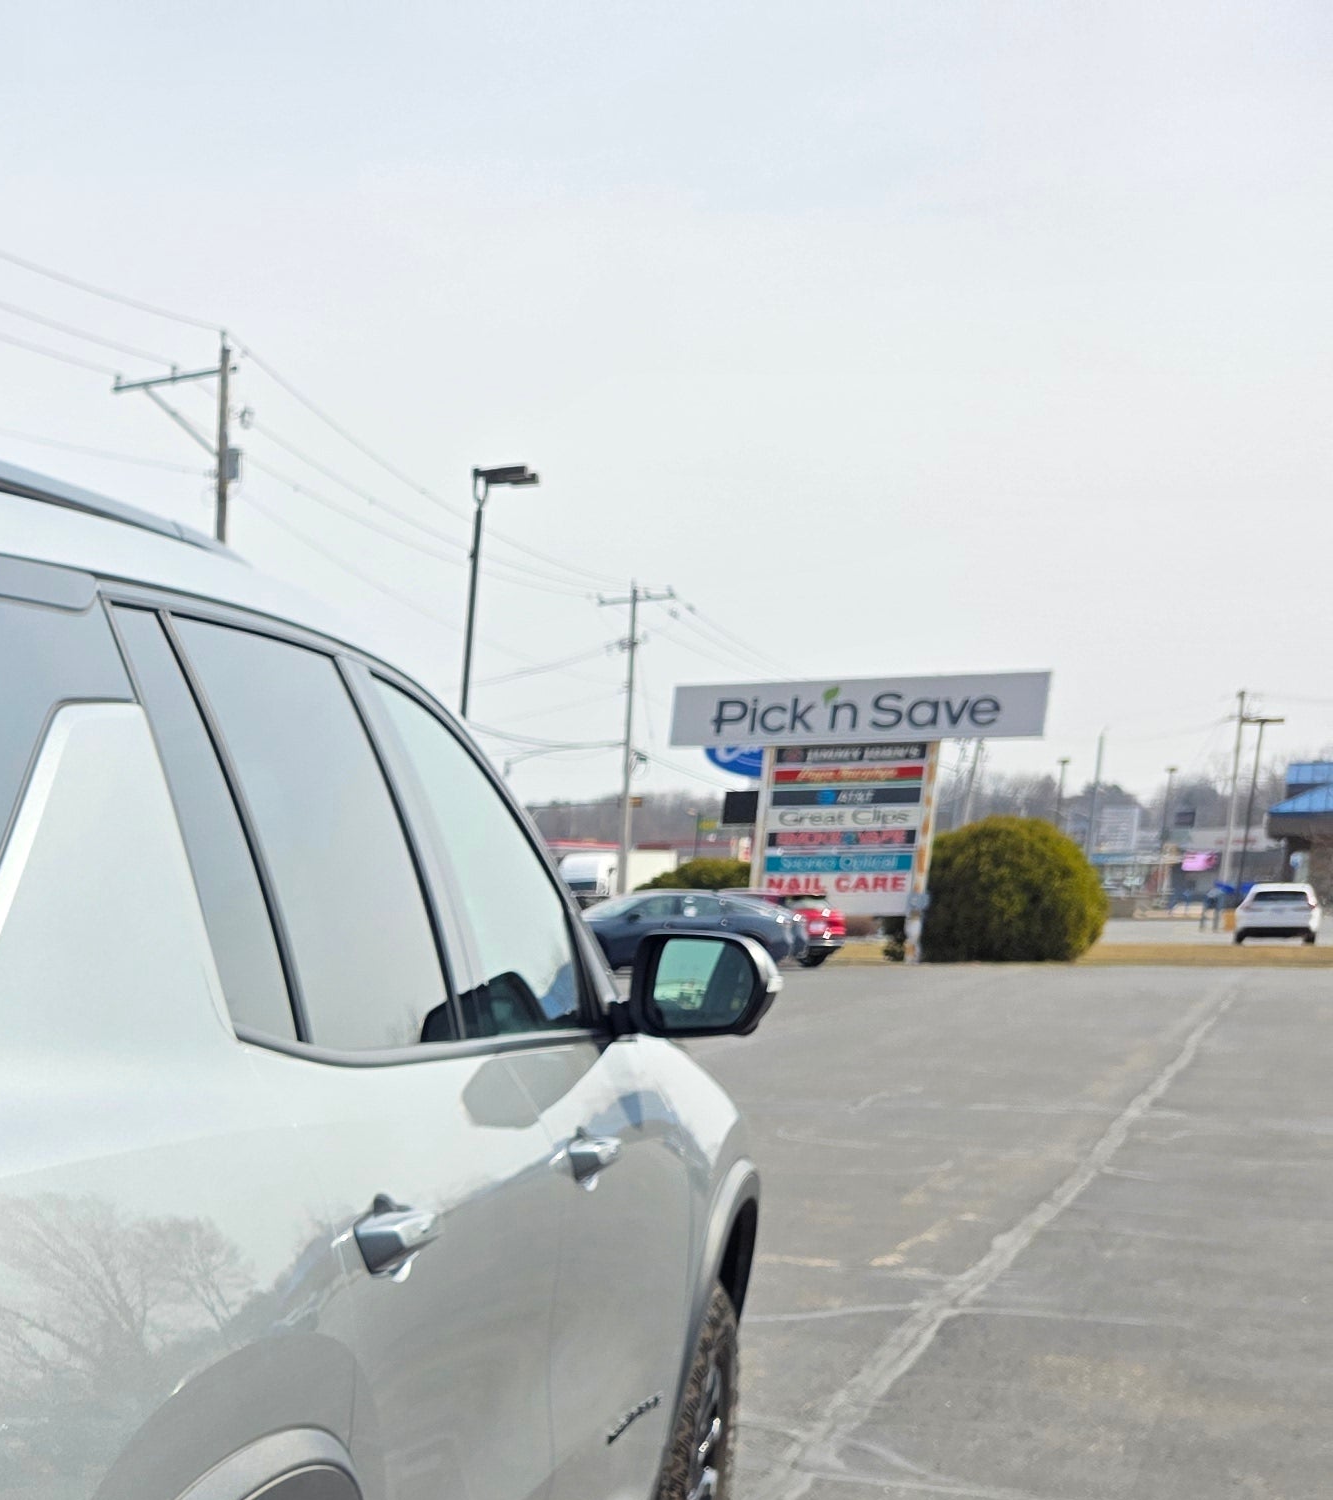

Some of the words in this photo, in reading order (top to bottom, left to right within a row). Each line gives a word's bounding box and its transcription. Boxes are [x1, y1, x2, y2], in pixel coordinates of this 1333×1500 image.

[712, 696, 816, 737] Pick
[870, 692, 1002, 731] Save
[779, 808, 845, 827] Great
[852, 806, 909, 826] Clips
[767, 876, 826, 894] NAIL
[835, 875, 907, 893] CARE
